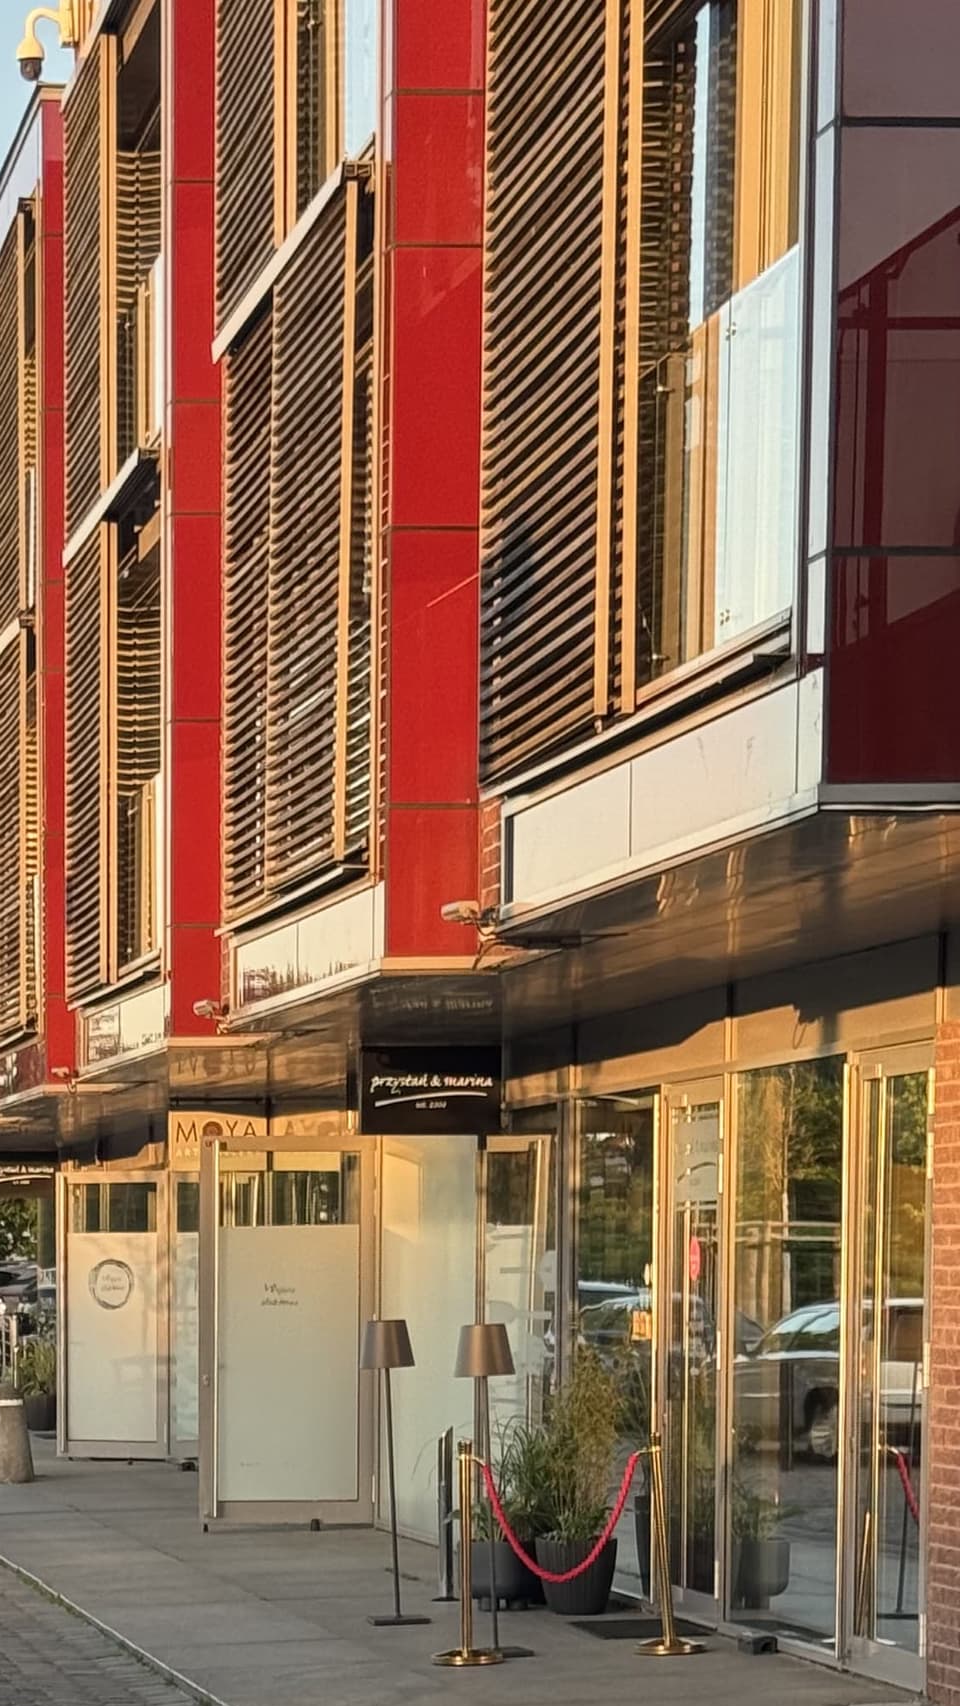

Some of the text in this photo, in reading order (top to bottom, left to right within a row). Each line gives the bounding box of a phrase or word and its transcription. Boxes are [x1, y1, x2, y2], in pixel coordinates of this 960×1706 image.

[430, 1075, 441, 1087] &
[444, 1074, 493, 1088] marina
[176, 1120, 257, 1143] MOYA
